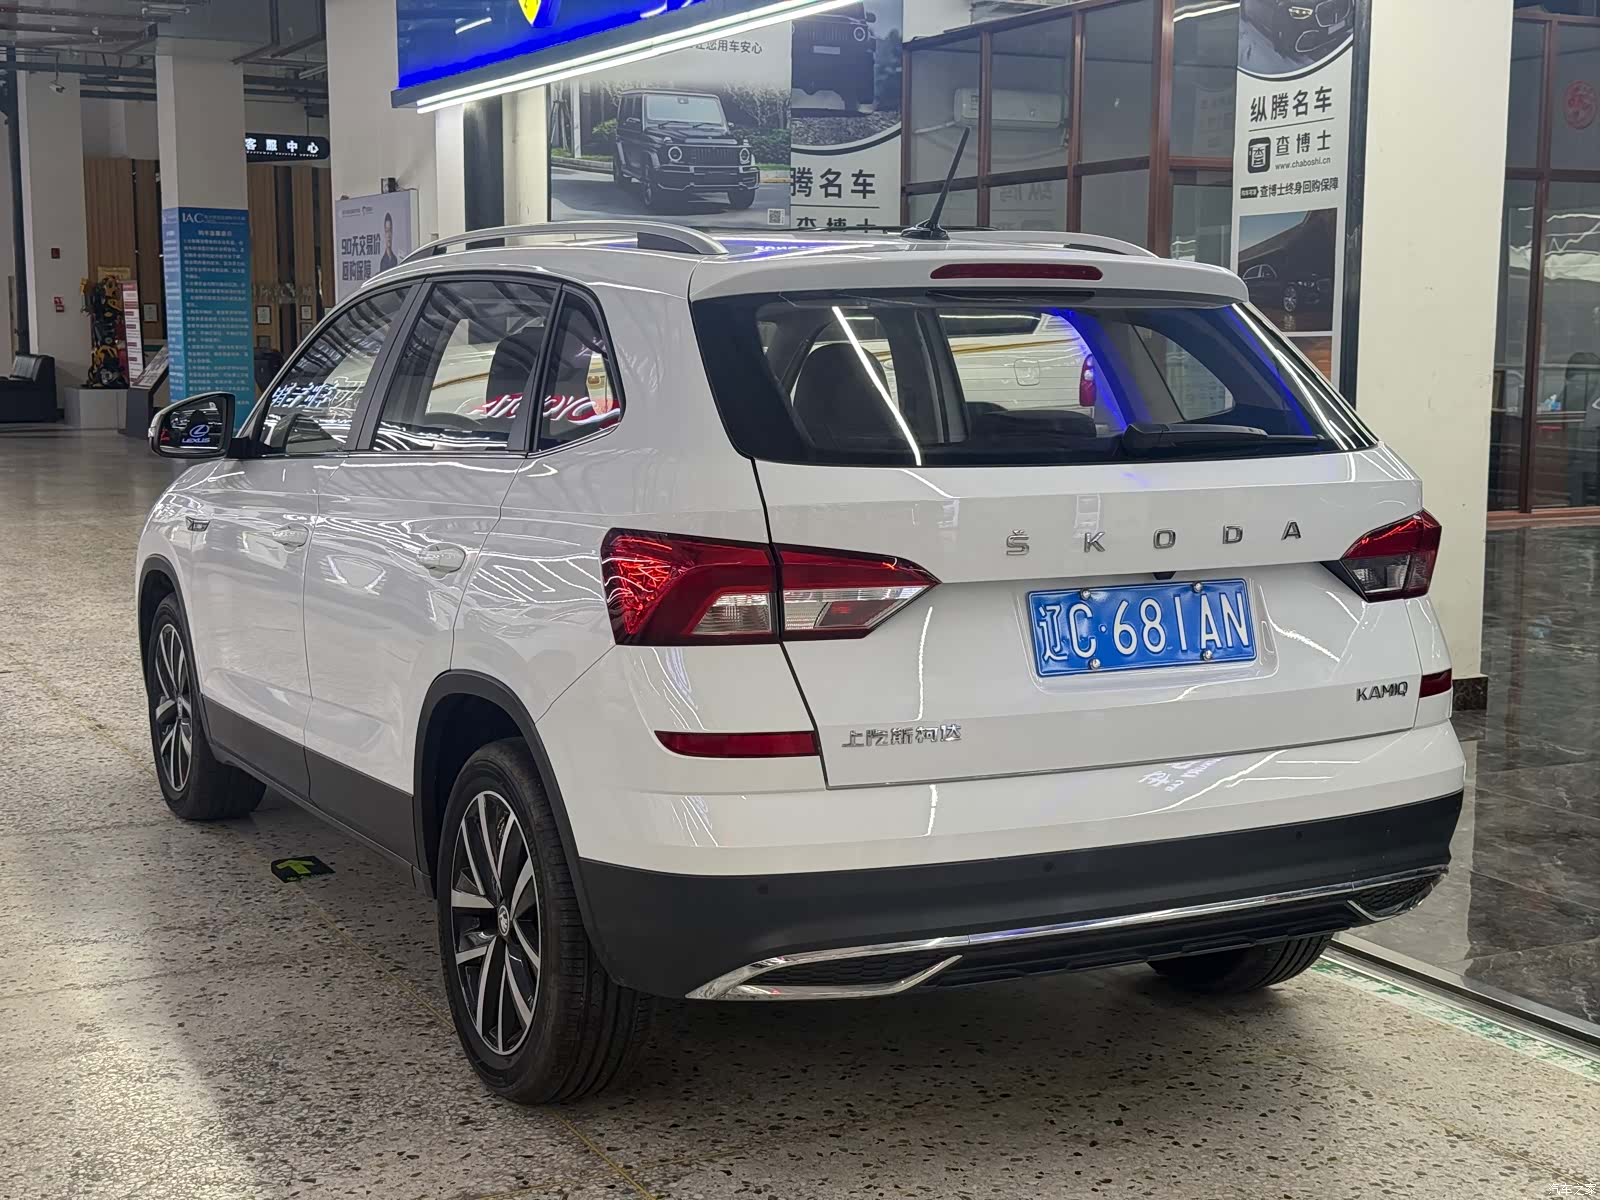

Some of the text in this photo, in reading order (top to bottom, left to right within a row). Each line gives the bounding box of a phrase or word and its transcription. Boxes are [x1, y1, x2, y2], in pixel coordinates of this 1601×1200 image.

[1250, 85, 1332, 123] 纵腾名车
[245, 137, 319, 154] 客服中心
[1275, 129, 1332, 157] 查博士
[1274, 157, 1331, 170] www.chaboshi.cn
[790, 166, 876, 200] 腾名车
[1260, 177, 1339, 199] 查博士终身回购保障
[341, 233, 381, 257] 90天交易价
[1356, 681, 1409, 702] KAMIQ
[841, 724, 962, 748] 上汽斯柯达
